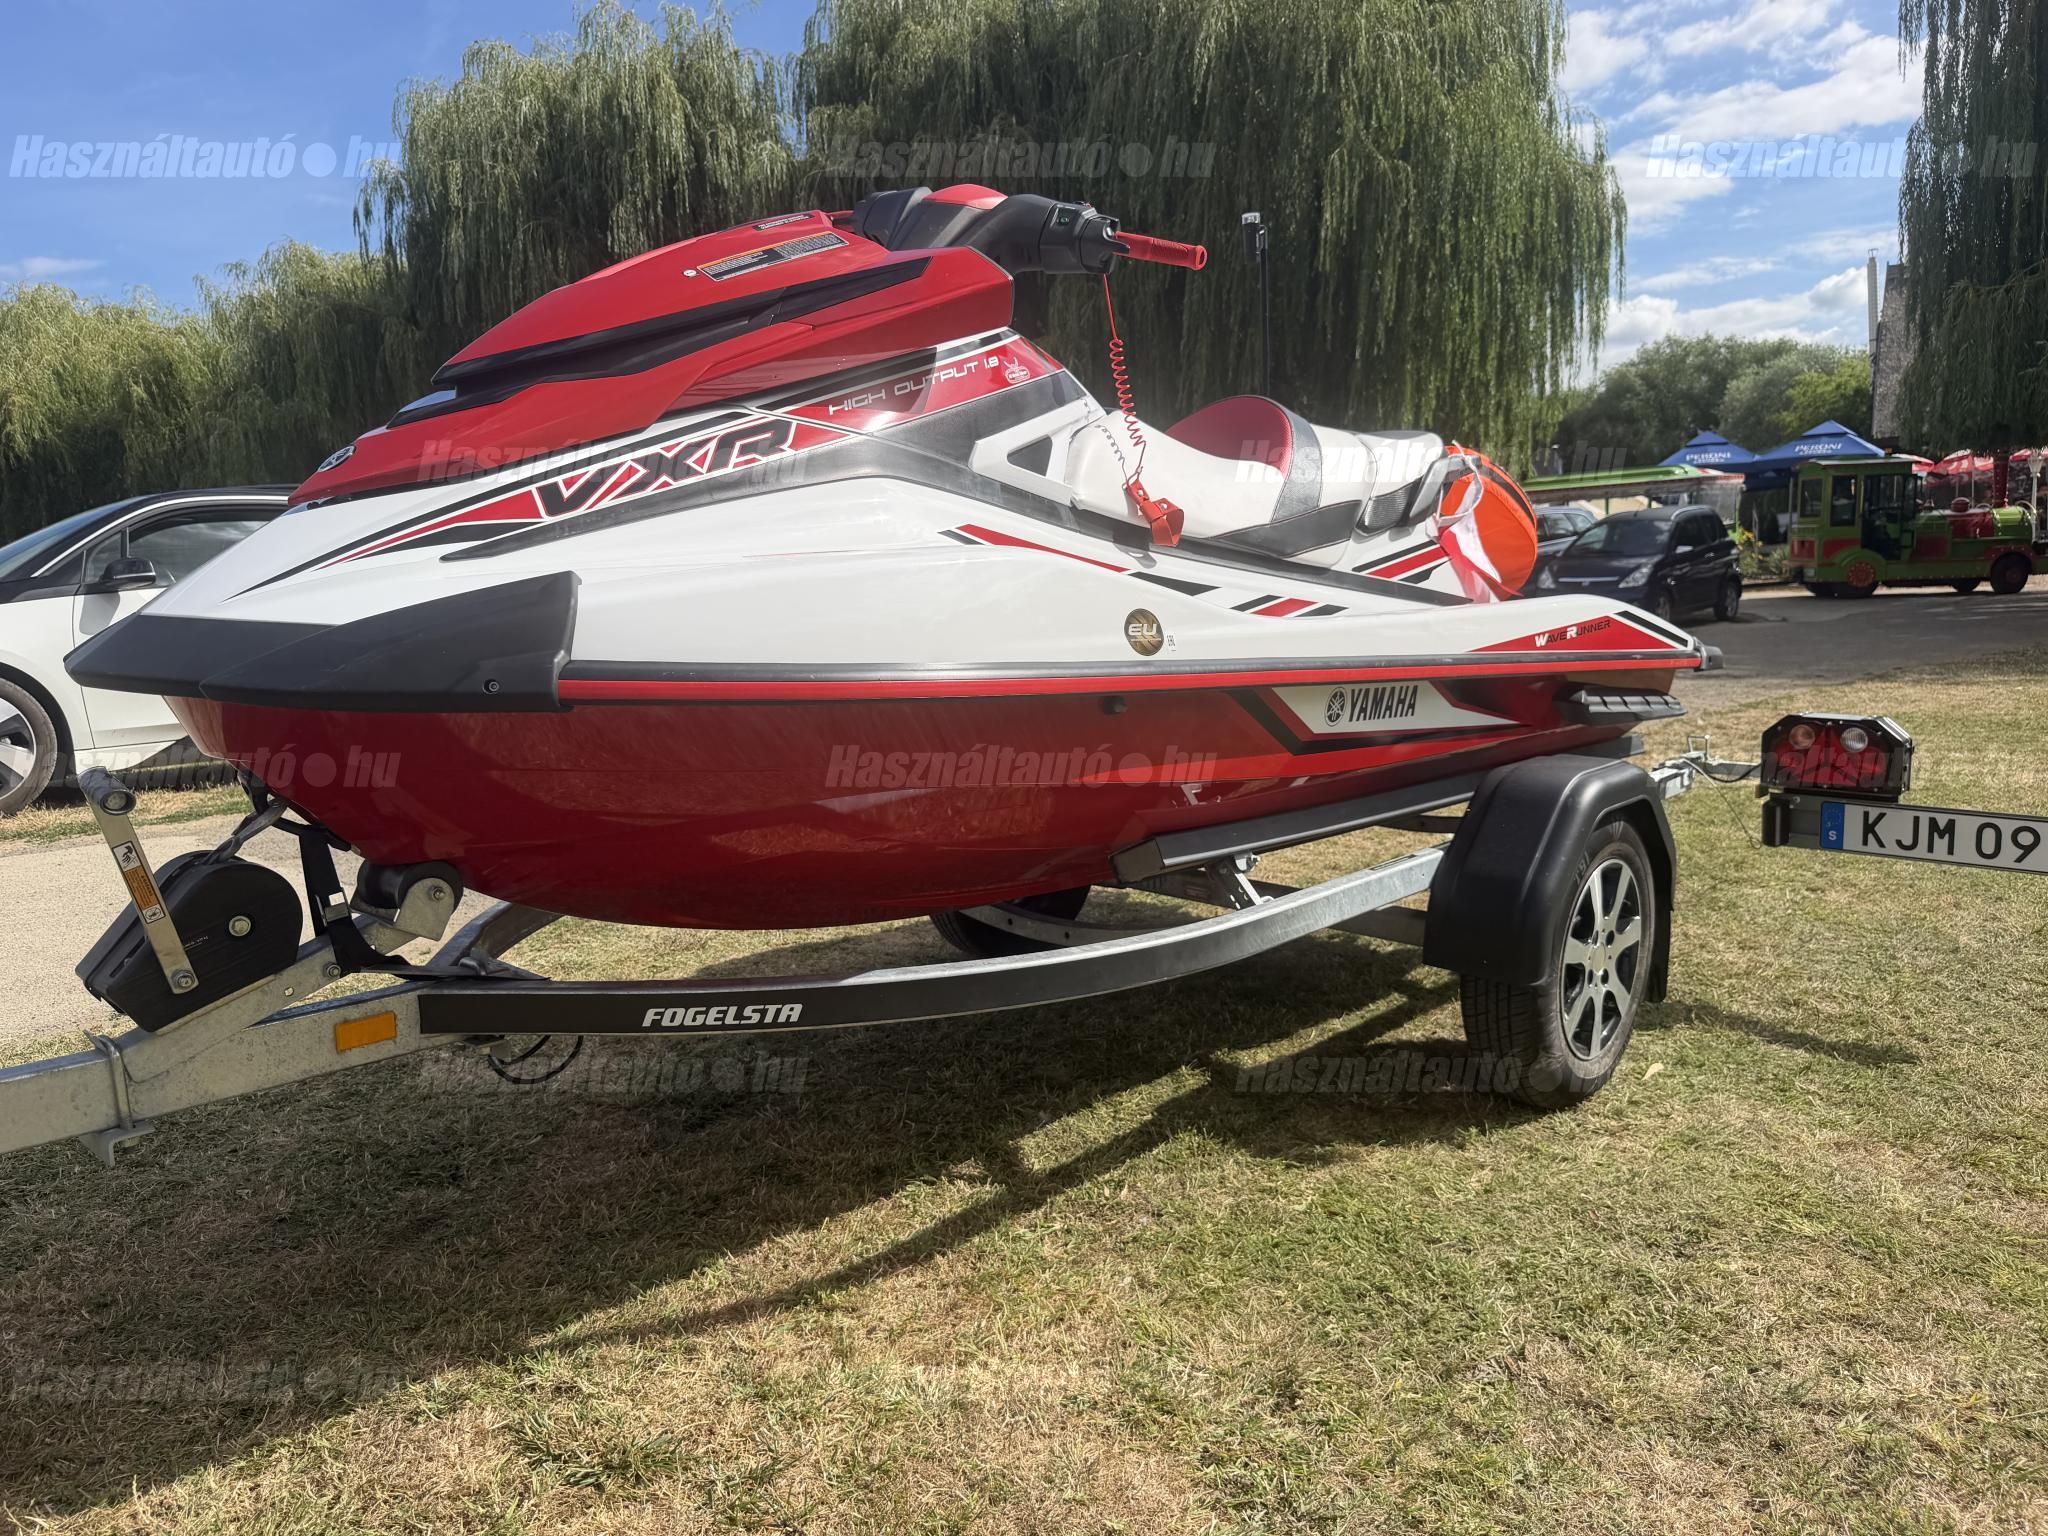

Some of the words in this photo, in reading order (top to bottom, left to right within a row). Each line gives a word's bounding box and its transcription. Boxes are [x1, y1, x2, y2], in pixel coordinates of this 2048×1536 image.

[829, 389, 886, 415] HIGH
[894, 362, 979, 396] OUTPUT
[534, 416, 798, 518] VXR
[1128, 623, 1157, 636] EU
[1348, 685, 1419, 723] YAMAHA
[1828, 830, 1837, 840] S
[1861, 810, 1956, 856] KJM
[1975, 821, 2041, 864] 09
[641, 1003, 803, 1027] FOGELSTA
